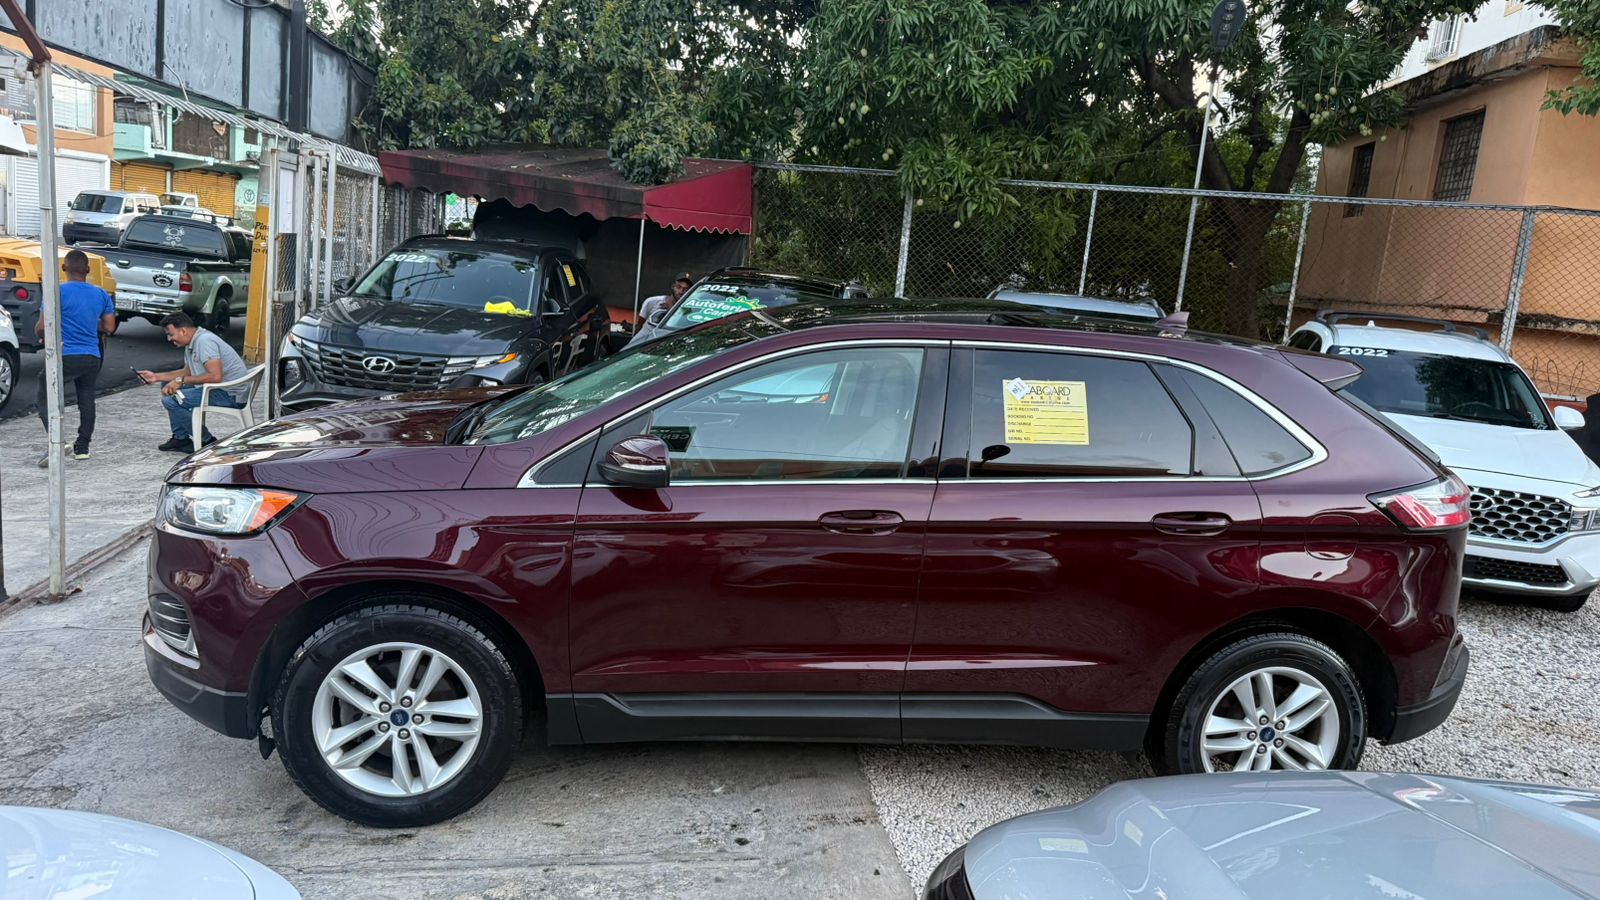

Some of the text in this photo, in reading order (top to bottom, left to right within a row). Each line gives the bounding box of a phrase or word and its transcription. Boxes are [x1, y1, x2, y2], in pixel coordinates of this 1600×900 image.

[384, 253, 428, 263] 2022
[700, 284, 739, 293] 2022
[1338, 347, 1388, 358] 2022
[1025, 386, 1071, 396] ABOARD
